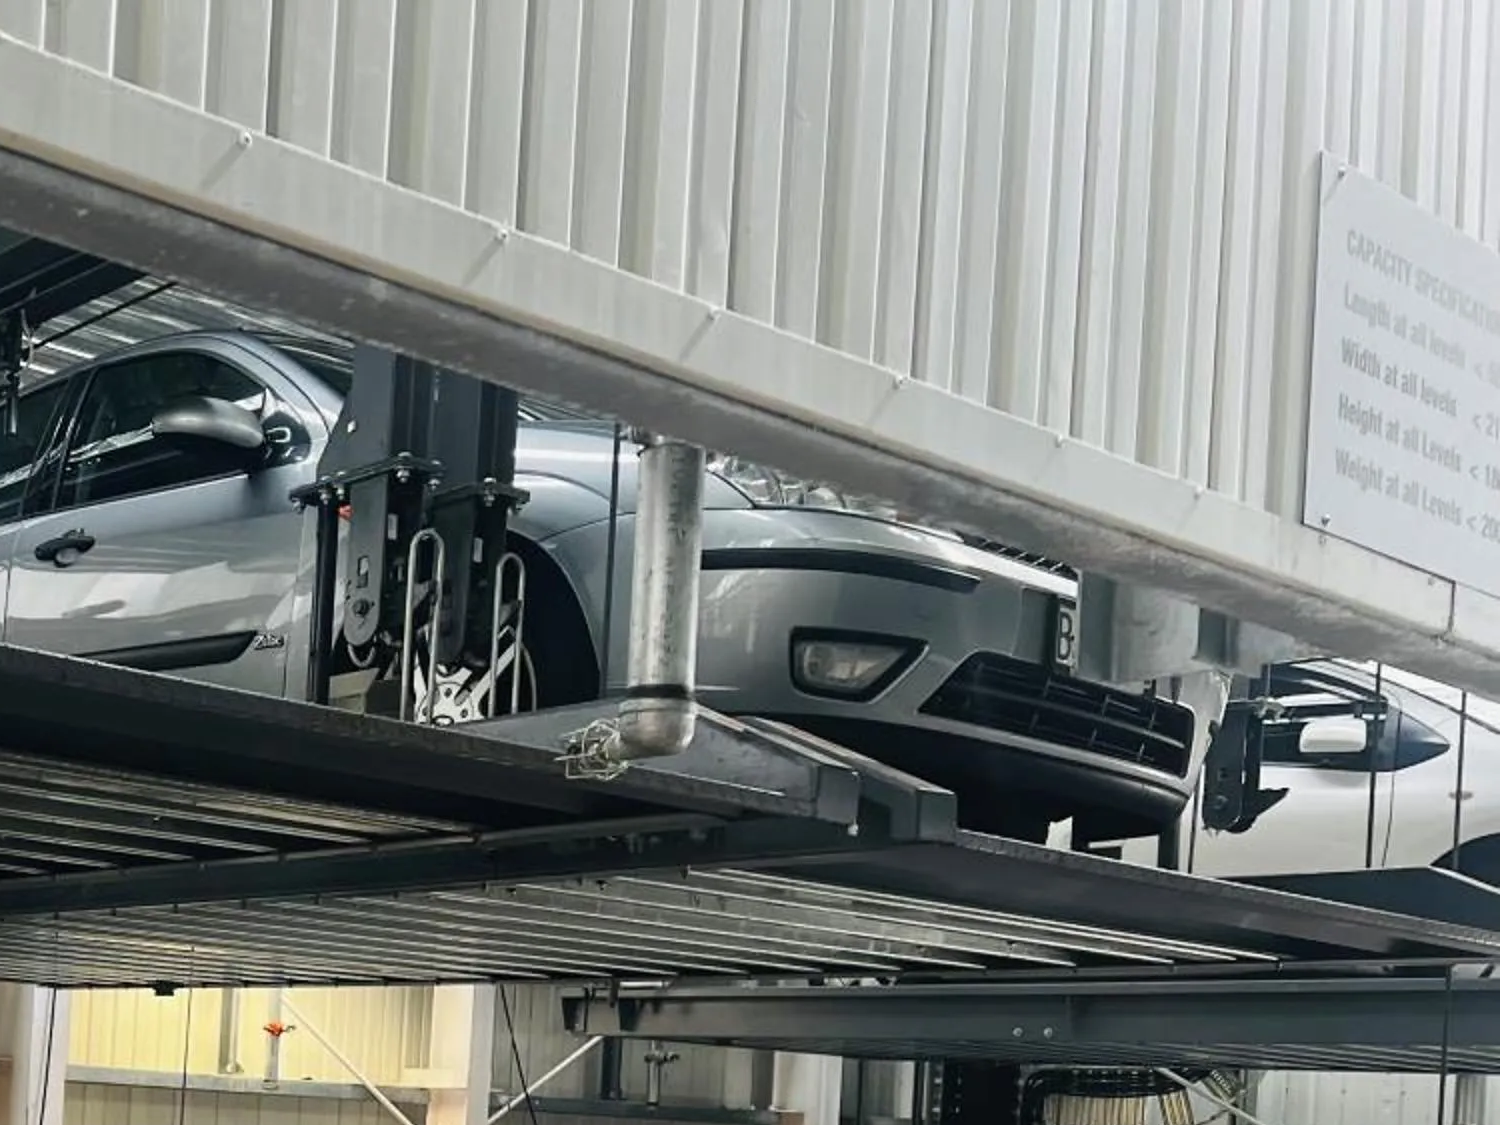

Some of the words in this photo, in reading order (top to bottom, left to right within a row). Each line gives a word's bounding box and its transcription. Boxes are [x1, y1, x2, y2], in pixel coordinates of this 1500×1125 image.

[1347, 229, 1412, 287] CAPACITY
[1342, 336, 1381, 380] Width
[1384, 364, 1398, 390] at
[1401, 370, 1418, 398] all
[1338, 392, 1383, 437] Height
[1385, 419, 1399, 445] at
[1403, 426, 1420, 453] all
[1422, 430, 1462, 473] Levels
[1336, 448, 1383, 493] Weight
[1385, 473, 1399, 499] at
[1402, 480, 1419, 507] all
[1422, 486, 1462, 526] Levels
